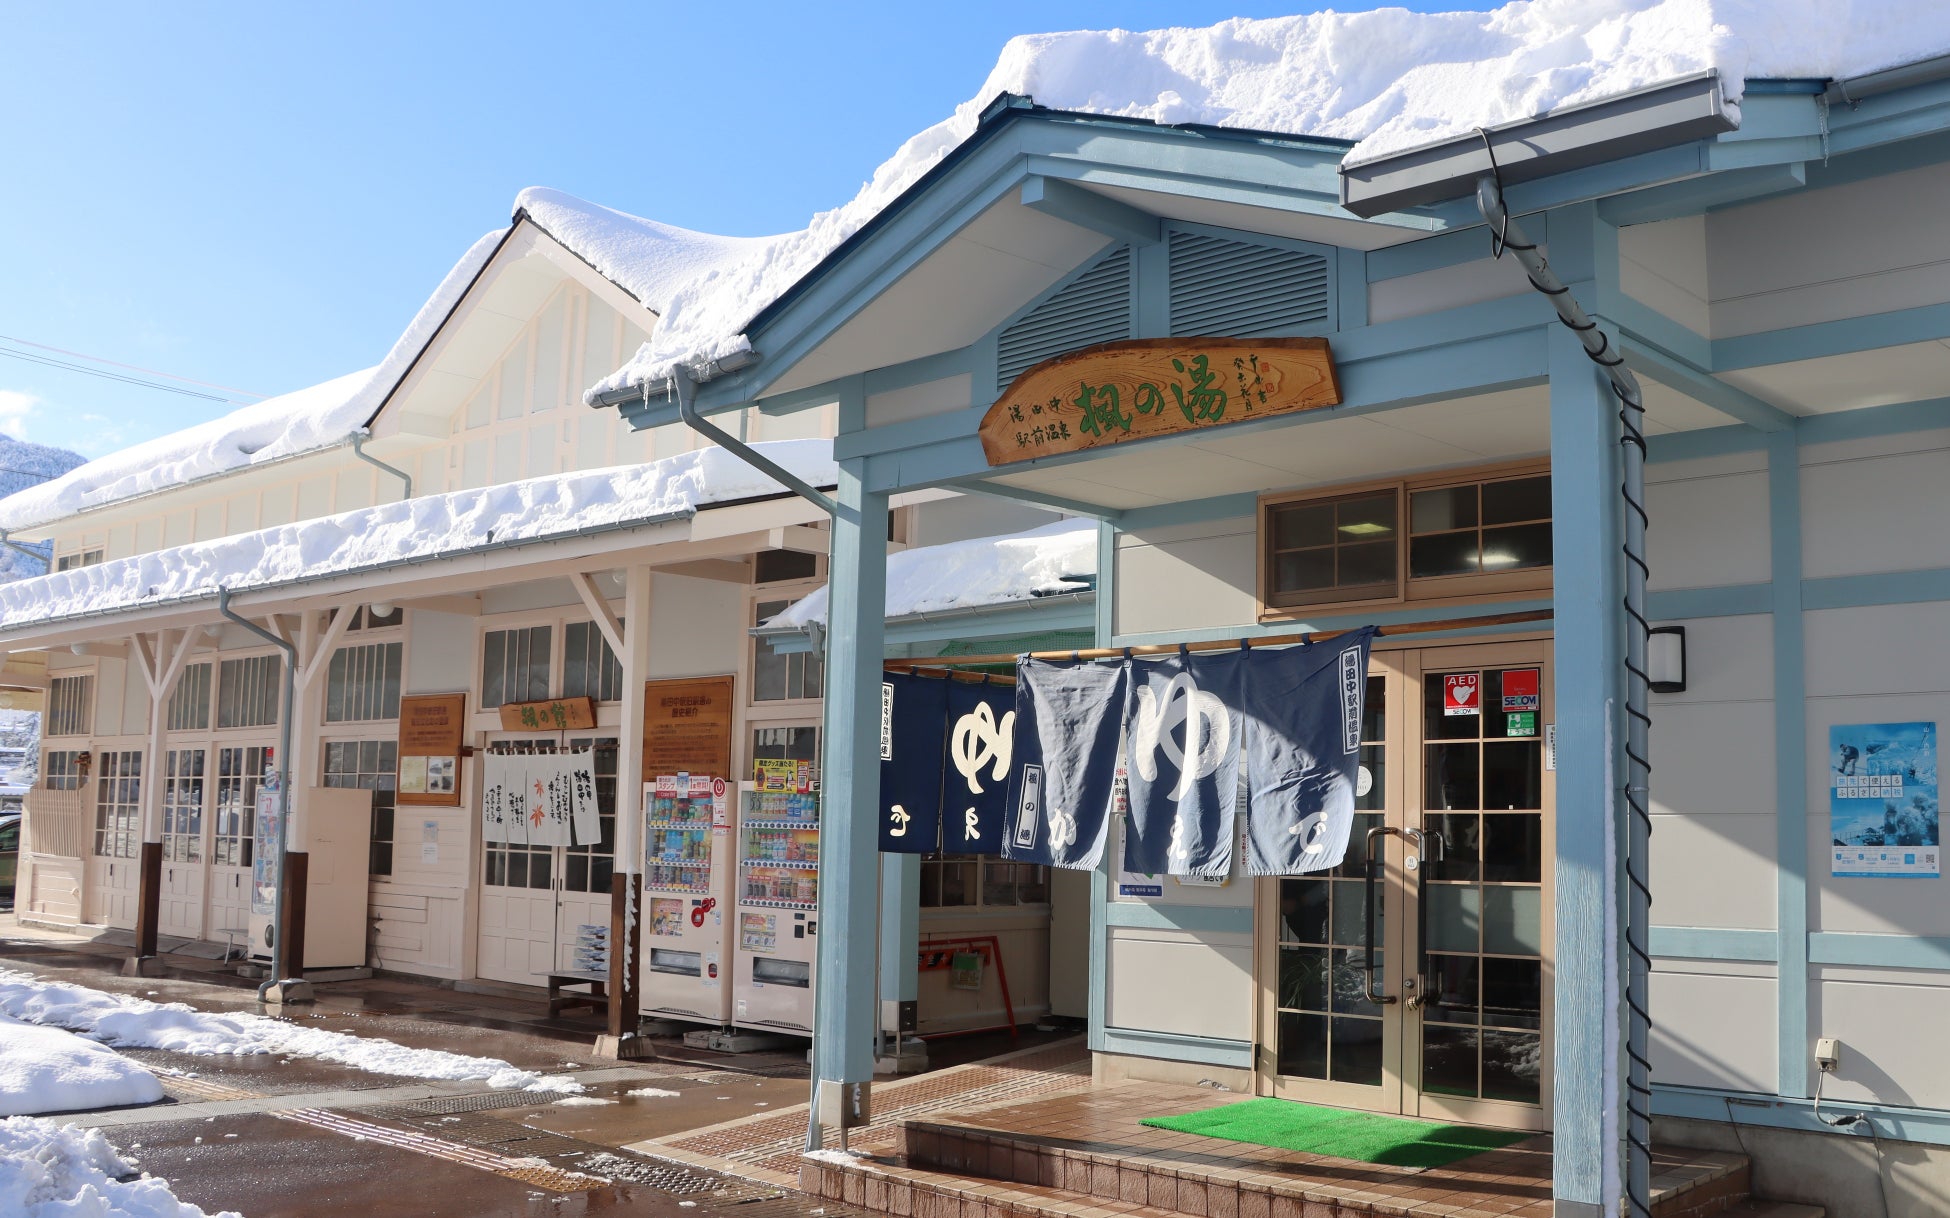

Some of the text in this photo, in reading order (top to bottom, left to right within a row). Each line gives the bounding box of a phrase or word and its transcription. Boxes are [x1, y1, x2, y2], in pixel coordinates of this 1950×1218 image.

[1074, 354, 1227, 437] 楓の湯
[1008, 397, 1061, 423] 湯田中
[1015, 420, 1072, 448] 駅前温泉
[1448, 675, 1477, 686] AED
[1344, 654, 1358, 747] 湯田中駅前温泉
[1504, 695, 1536, 706] SECOM
[1136, 672, 1231, 802] ゆ
[1838, 776, 1901, 786] 旅先で使える
[1838, 788, 1903, 798] ふるさと納税
